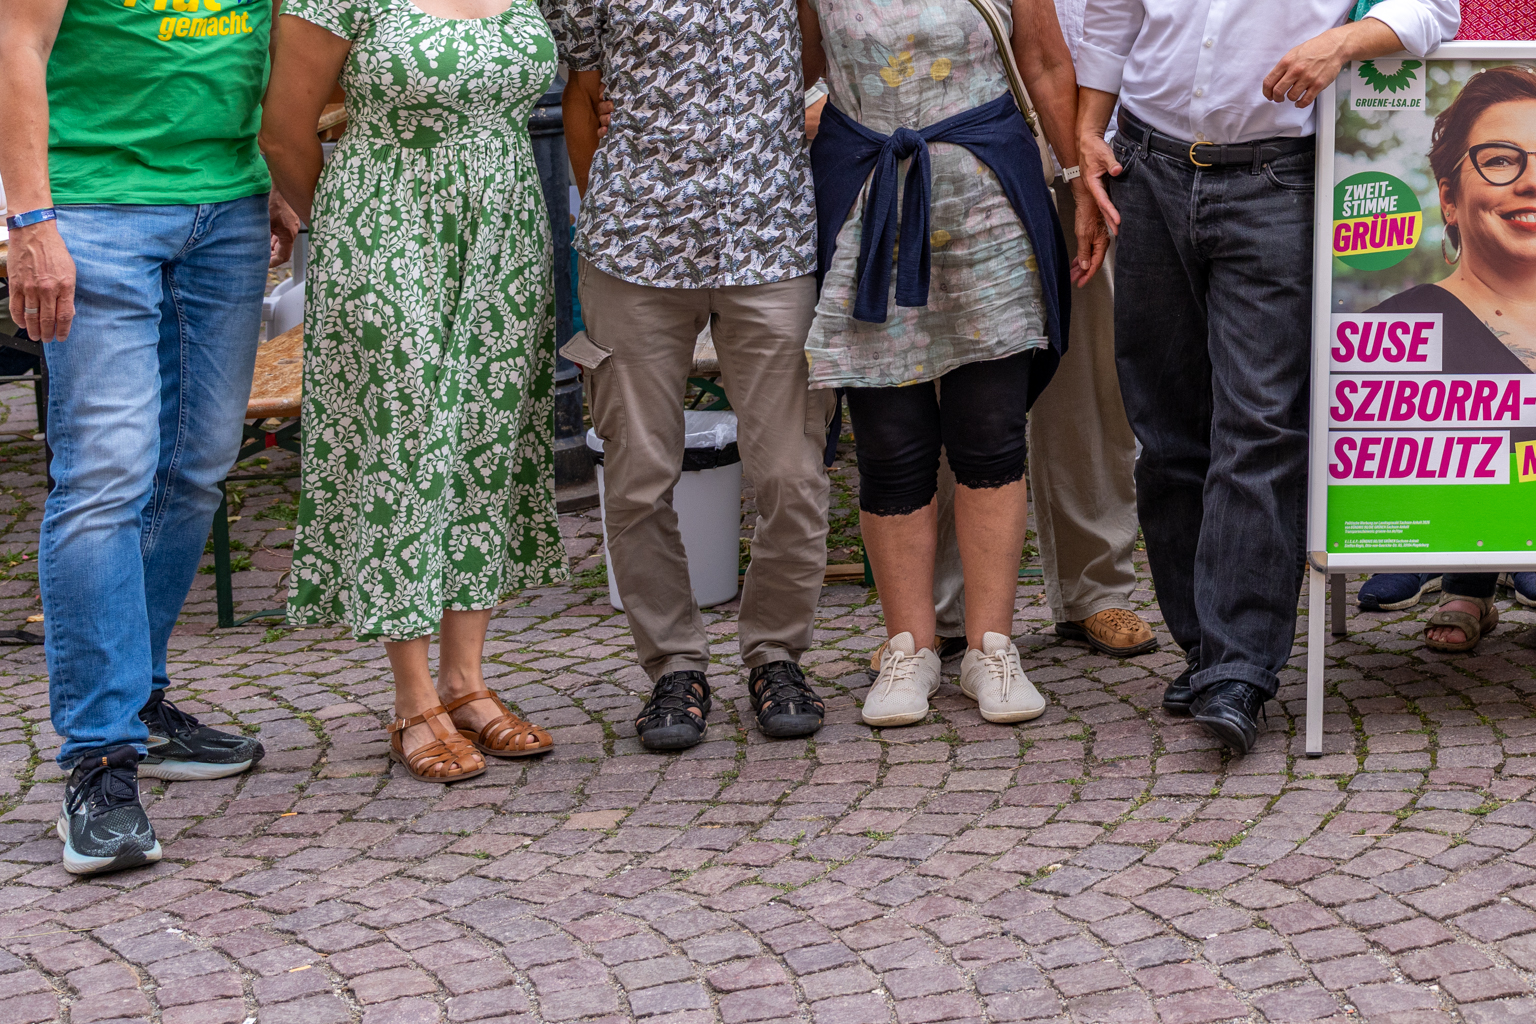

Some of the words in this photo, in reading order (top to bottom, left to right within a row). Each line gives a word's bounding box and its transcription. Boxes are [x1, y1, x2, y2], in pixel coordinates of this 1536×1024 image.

[157, 11, 253, 42] gemacht.
[1355, 98, 1422, 108] GRUENE-LSA.DE
[1342, 195, 1399, 217] STIMME
[1343, 180, 1393, 201] ZWEIT-
[1333, 212, 1416, 253] GRÜN!
[1331, 321, 1435, 363] SUSE
[1328, 436, 1504, 480] SEIDLITZ
